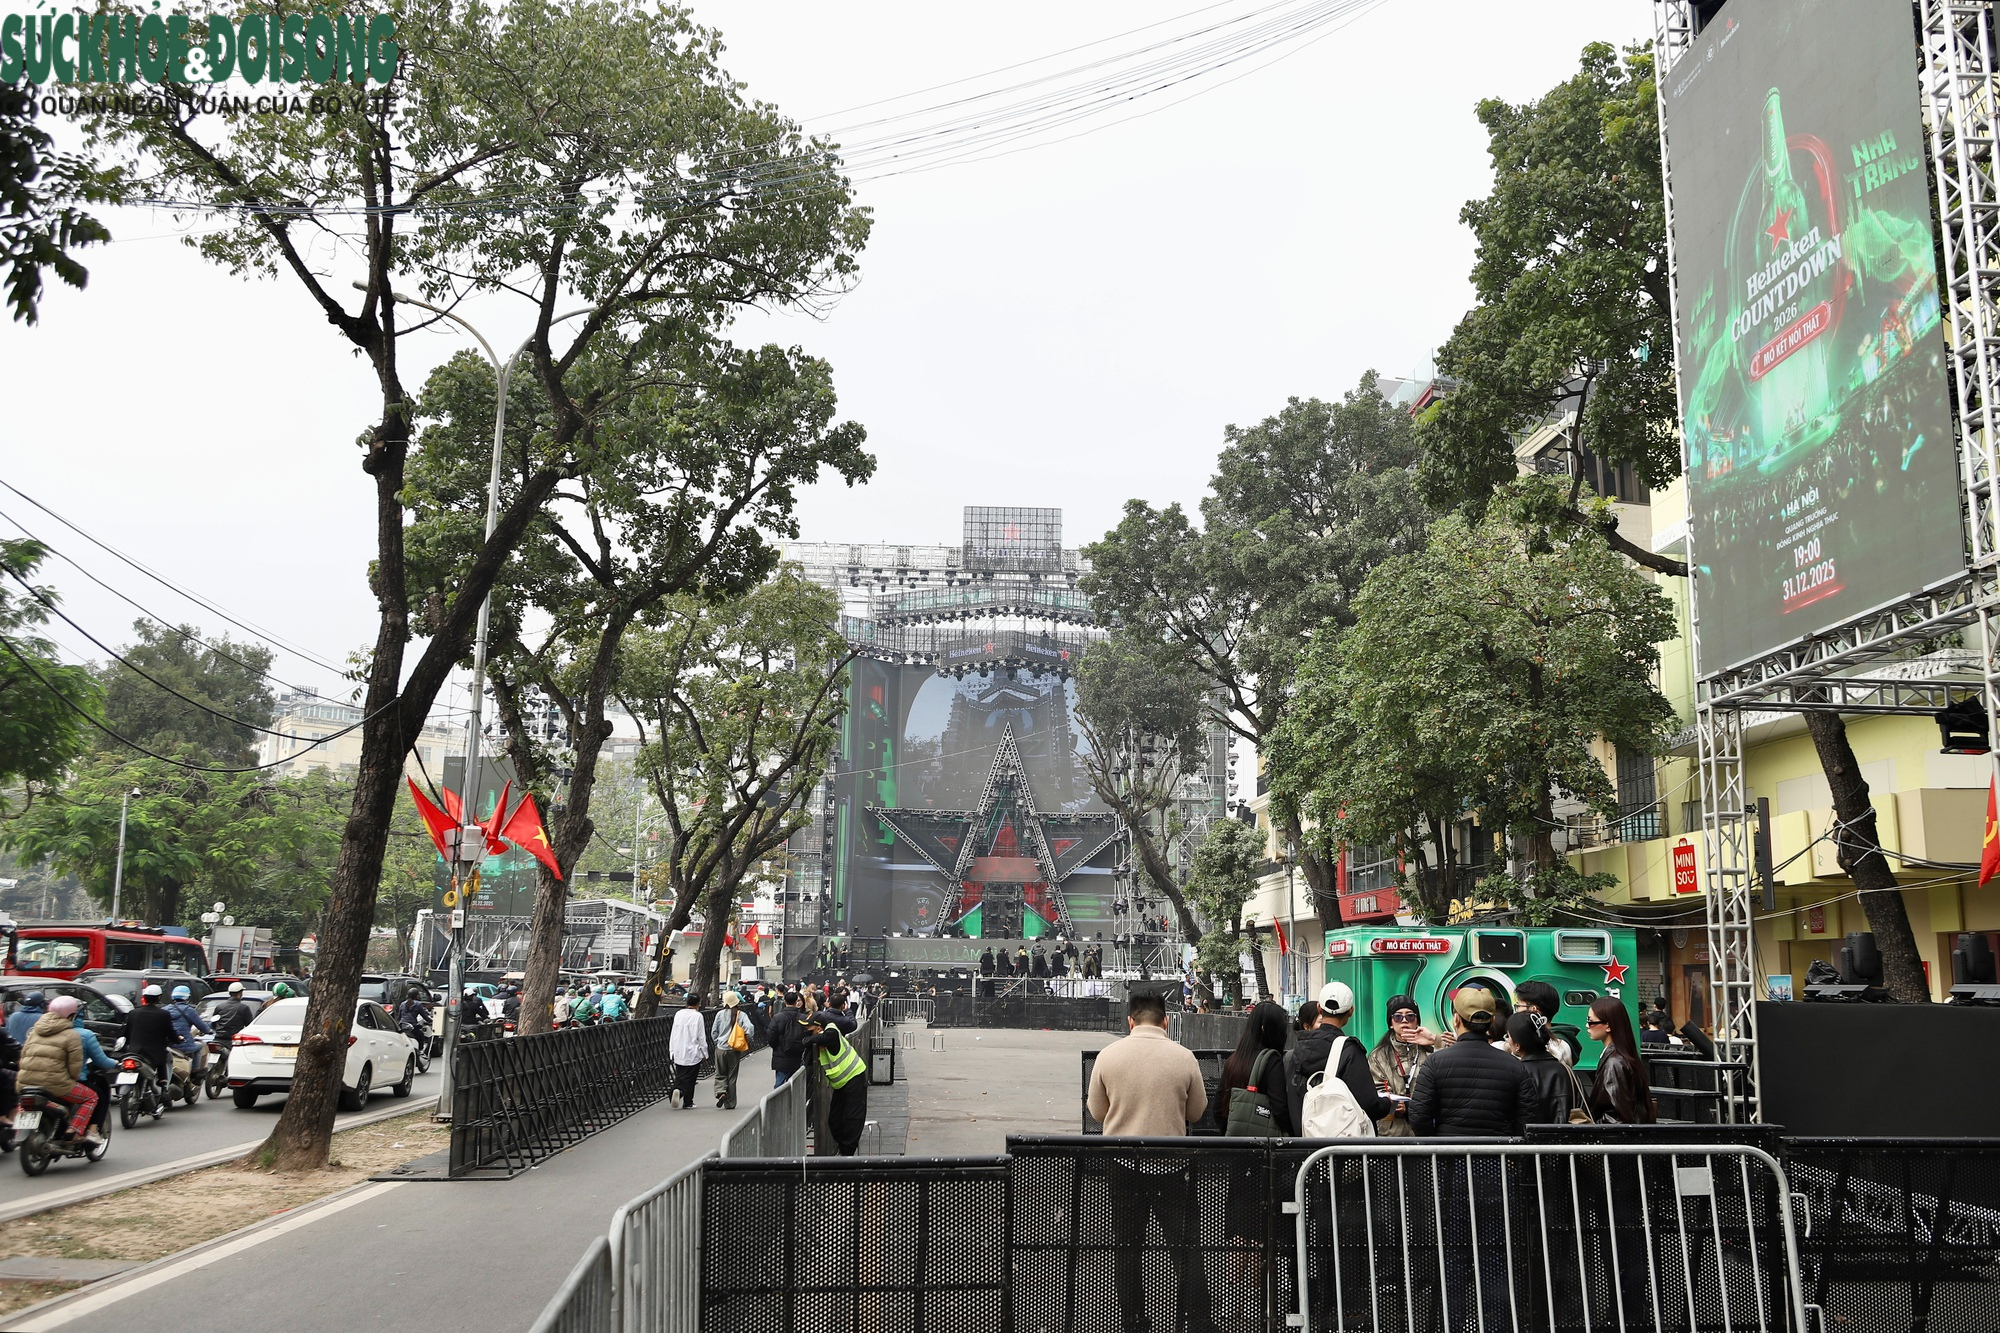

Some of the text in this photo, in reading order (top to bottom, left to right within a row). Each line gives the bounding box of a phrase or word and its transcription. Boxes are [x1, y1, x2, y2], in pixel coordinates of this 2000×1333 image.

[1850, 129, 1898, 168] NHA
[1846, 148, 1919, 199] TRANG
[1746, 225, 1821, 301] Heineken
[1731, 232, 1842, 343] COUNTDOWN
[1773, 302, 1798, 332] 2026
[1763, 313, 1820, 367] MỞ KẾT NỐI THẬT
[1786, 496, 1800, 516] HÀ
[1792, 529, 1806, 543] KINH
[1793, 537, 1821, 568] 19:00
[1782, 558, 1836, 601] 31.12.2025
[1675, 852, 1694, 868] MINI
[1386, 939, 1442, 951] MỞ KẾT NỐI THẬT
